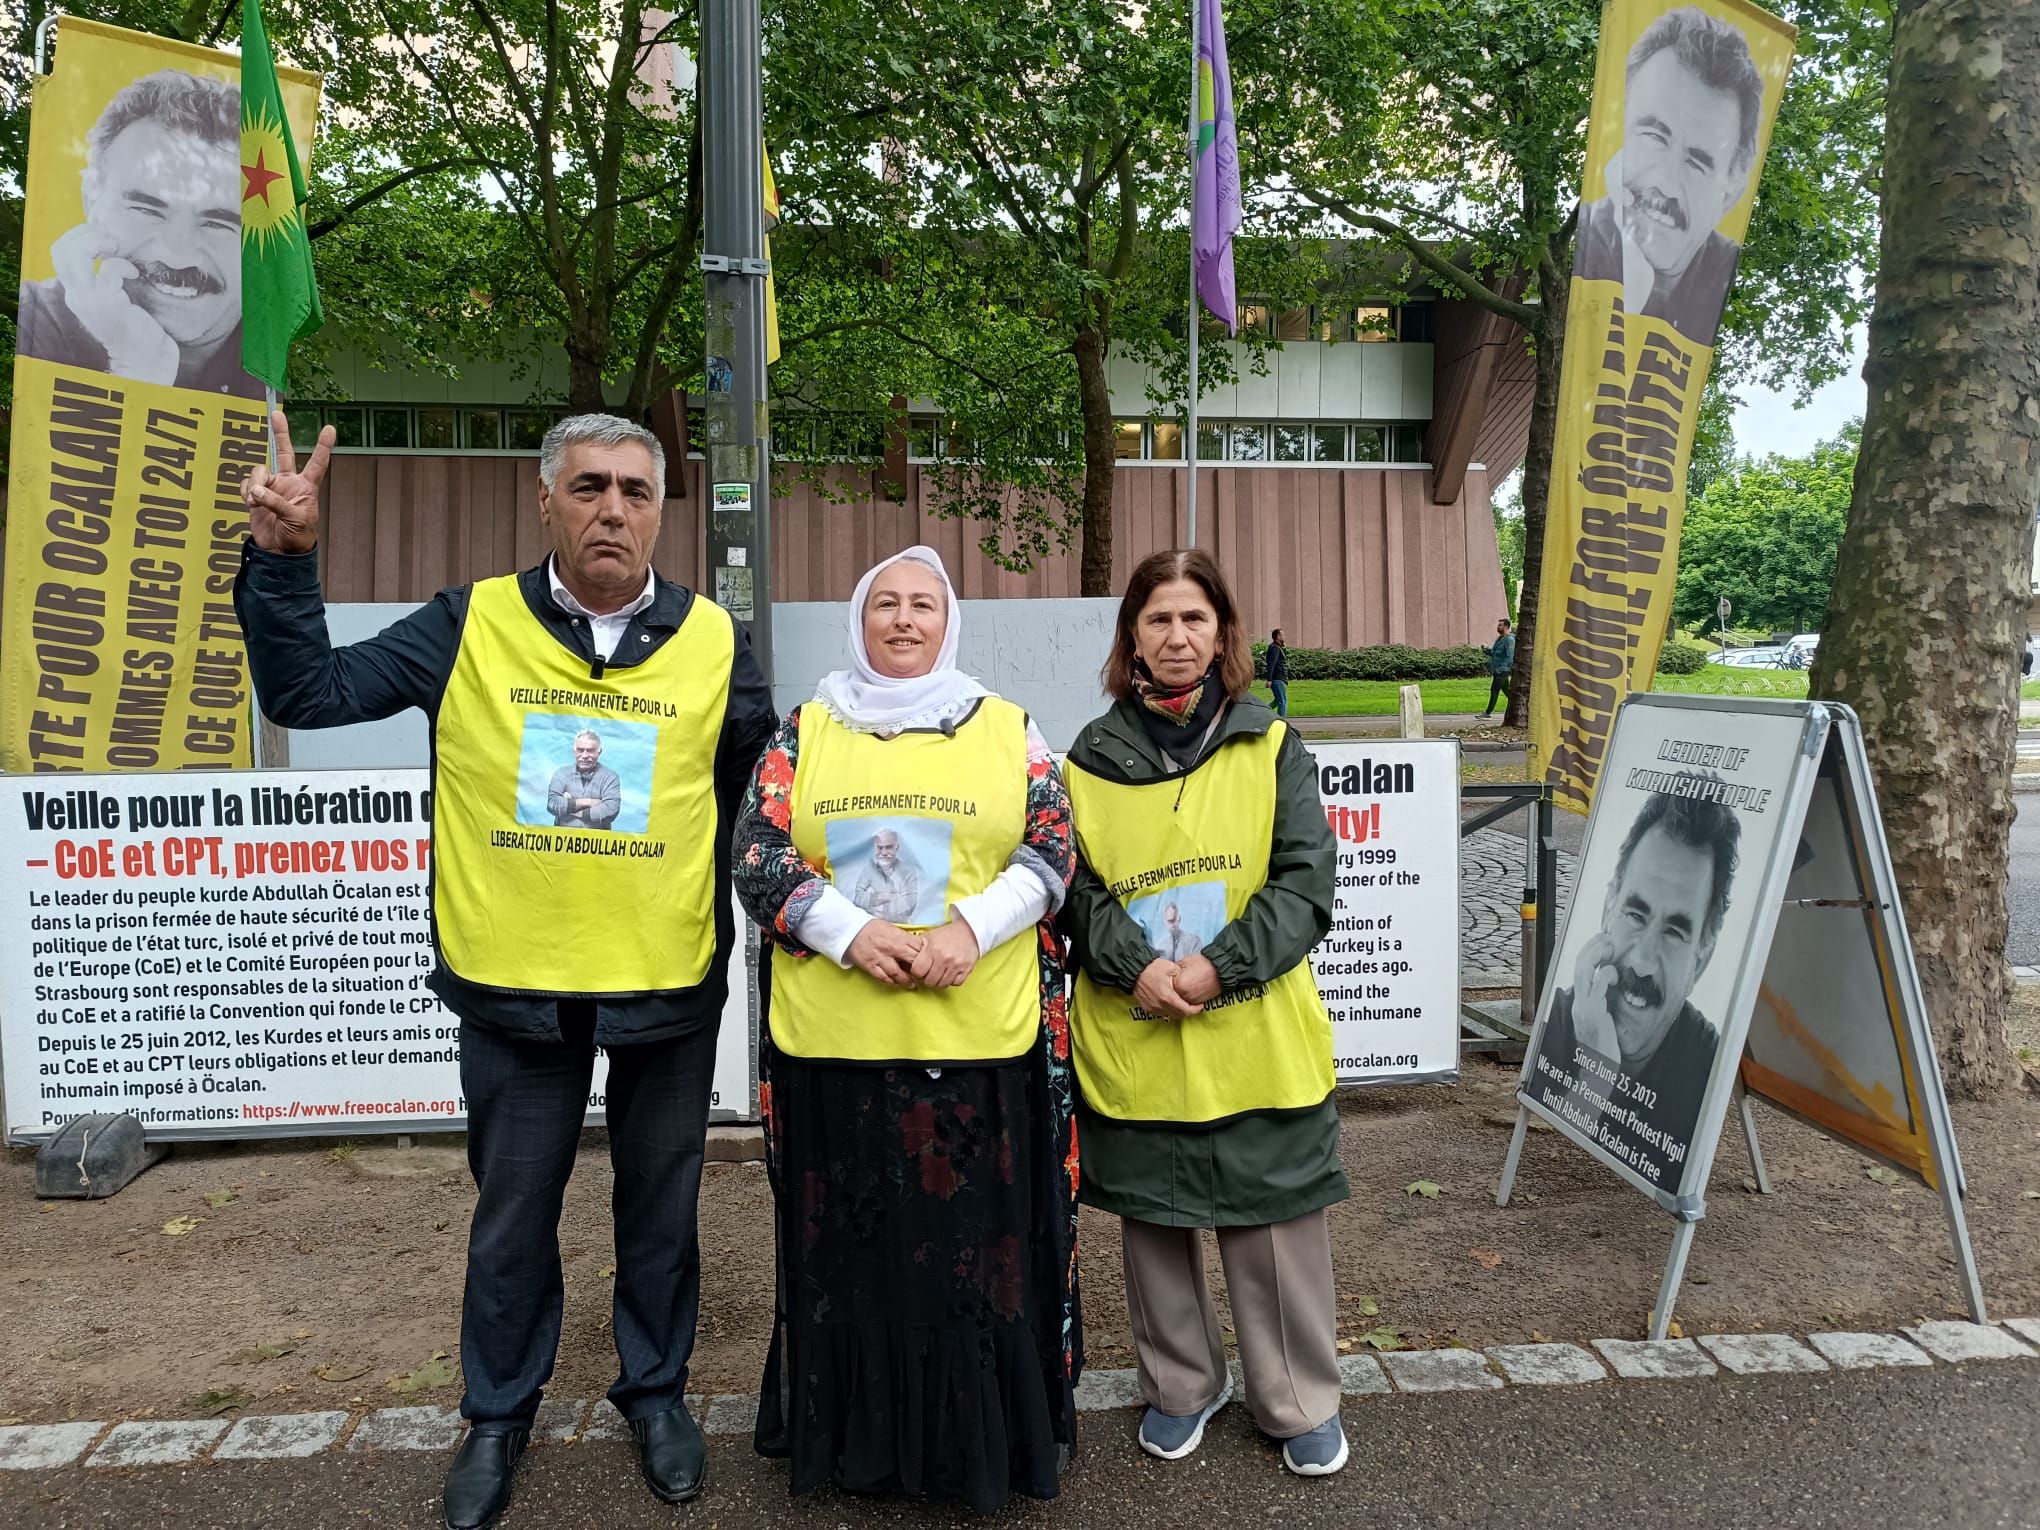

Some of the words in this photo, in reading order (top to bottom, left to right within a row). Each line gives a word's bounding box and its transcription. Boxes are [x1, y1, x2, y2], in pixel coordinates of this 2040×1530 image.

[1626, 331, 1693, 493] UNITE!
[141, 407, 205, 490] 24/7,
[41, 377, 125, 576] OCALAN!
[133, 494, 190, 549] TOI
[1570, 507, 1628, 598] FOR
[1627, 502, 1668, 575] WE
[126, 557, 184, 644] AVEC
[33, 582, 106, 705] POUR
[189, 649, 245, 709] QUE
[107, 650, 174, 771] OMMES
[510, 688, 548, 705] VEILLE
[551, 689, 628, 712] PERMANENTE
[632, 697, 661, 716] POUR
[664, 703, 677, 718] LA
[1545, 597, 1627, 808] FREEDOM
[184, 715, 237, 755] CE
[1657, 739, 1724, 768] LEADER
[1722, 747, 1750, 771] OF
[1321, 759, 1414, 795] calan
[1626, 768, 1701, 800] KURDISH
[1700, 780, 1771, 813] PEOPLE
[23, 791, 120, 830] Veille
[128, 795, 204, 832] pour
[212, 789, 243, 826] la
[251, 785, 412, 825] libération
[814, 798, 848, 816] VEILLE
[851, 794, 926, 810] PERMANENTE
[930, 796, 960, 813] POUR
[964, 801, 977, 816] LA
[56, 840, 115, 878] CoE
[123, 841, 156, 876] et
[163, 837, 227, 878] CPT,
[234, 841, 345, 878] prenez
[352, 840, 408, 871] vos
[491, 830, 551, 851] LIBERATION
[555, 835, 626, 856] D'ABDULLAH
[630, 840, 665, 858] OCALAN
[1358, 849, 1395, 864] 1999
[1199, 855, 1227, 872] POUR
[1229, 854, 1242, 869] LA
[30, 891, 50, 906] Le
[55, 890, 108, 906] leader
[113, 889, 133, 904] du
[139, 888, 195, 907] peuple
[200, 886, 248, 902] kurde
[252, 884, 328, 901] Abdullah
[333, 880, 391, 899] Öcalan
[396, 884, 420, 897] est
[1336, 875, 1375, 887] soner
[1380, 871, 1393, 885] of
[1397, 871, 1419, 885] the
[32, 915, 71, 930] dans
[76, 914, 90, 929] la
[96, 913, 147, 932] prison
[153, 911, 211, 927] fermée
[216, 910, 235, 925] de
[240, 910, 287, 924] haute
[292, 907, 358, 923] sécurité
[364, 907, 382, 921] de
[1330, 917, 1373, 931] ention
[1378, 915, 1392, 929] of
[33, 937, 107, 957] politique
[112, 936, 132, 951] de
[137, 935, 180, 951] l'état
[185, 936, 223, 951] turc,
[228, 932, 267, 948] isolé
[272, 934, 288, 947] et
[293, 931, 333, 950] privé
[339, 931, 358, 945] de
[363, 931, 395, 945] tout
[1323, 938, 1373, 955] Turkey
[1379, 937, 1390, 951] is
[1394, 940, 1402, 950] a
[34, 962, 54, 977] de
[59, 961, 130, 979] l'Europe
[135, 957, 181, 976] (CoE)
[186, 959, 202, 973] et
[207, 957, 221, 972] le
[227, 955, 285, 971] Comité
[290, 954, 368, 973] Européen
[374, 956, 411, 972] pour
[415, 952, 429, 967] la
[1318, 960, 1378, 975] decades
[1382, 961, 1413, 976] ago.
[35, 985, 128, 1002] Strasbourg
[133, 984, 169, 998] sont
[174, 979, 283, 1000] responsables
[289, 978, 307, 993] de
[313, 978, 327, 993] la
[332, 976, 403, 992] situation
[1318, 985, 1362, 1000] emind
[1367, 984, 1390, 998] the
[37, 1009, 57, 1024] du
[62, 1008, 96, 1023] CoE
[101, 1009, 117, 1022] et
[122, 1011, 130, 1022] a
[136, 1005, 185, 1021] ratifié
[190, 1005, 205, 1020] la
[210, 1002, 304, 1019] Convention
[310, 1000, 334, 1020] qui
[340, 1000, 385, 1015] fonde
[390, 999, 404, 1014] le
[410, 997, 442, 1013] CPT
[1328, 1008, 1345, 1021] he
[1350, 1006, 1421, 1021] inhumane
[39, 1035, 96, 1055] Depuis
[101, 1035, 116, 1049] le
[121, 1034, 143, 1049] 25
[148, 1032, 178, 1052] juin
[184, 1031, 230, 1048] 2012,
[236, 1030, 259, 1045] les
[265, 1028, 322, 1044] Kurdes
[327, 1029, 343, 1042] et
[348, 1027, 388, 1042] leurs
[393, 1025, 430, 1040] amis
[40, 1064, 59, 1075] au
[65, 1058, 98, 1074] CoE
[103, 1059, 119, 1073] et
[124, 1061, 143, 1072] au
[149, 1056, 184, 1071] CPT
[189, 1055, 230, 1070] leurs
[235, 1052, 327, 1071] obligations
[332, 1052, 347, 1065] et
[352, 1050, 384, 1065] leur
[389, 1047, 460, 1064] demande
[41, 1081, 118, 1098] inhumain
[124, 1079, 183, 1099] imposé
[188, 1078, 197, 1093] à
[202, 1074, 266, 1092] Öcalan.
[1573, 1047, 1596, 1072] Since
[1595, 1061, 1617, 1085] June
[1616, 1073, 1631, 1096] 25,
[1632, 1083, 1657, 1109] 2012
[243, 1100, 455, 1122] https://www.freeocalan.org
[1538, 1054, 1550, 1071] We
[1550, 1064, 1562, 1082] are
[1563, 1070, 1572, 1088] in
[1572, 1080, 1578, 1092] a
[1579, 1081, 1627, 1124] Permanent
[1626, 1111, 1662, 1147] Protest
[1662, 1133, 1686, 1163] Vigil
[1543, 1087, 1562, 1111] Until
[1562, 1101, 1599, 1137] Abdullah
[1600, 1122, 1629, 1159] Öcalan
[1629, 1146, 1639, 1164] is
[1638, 1152, 1661, 1181] Free
